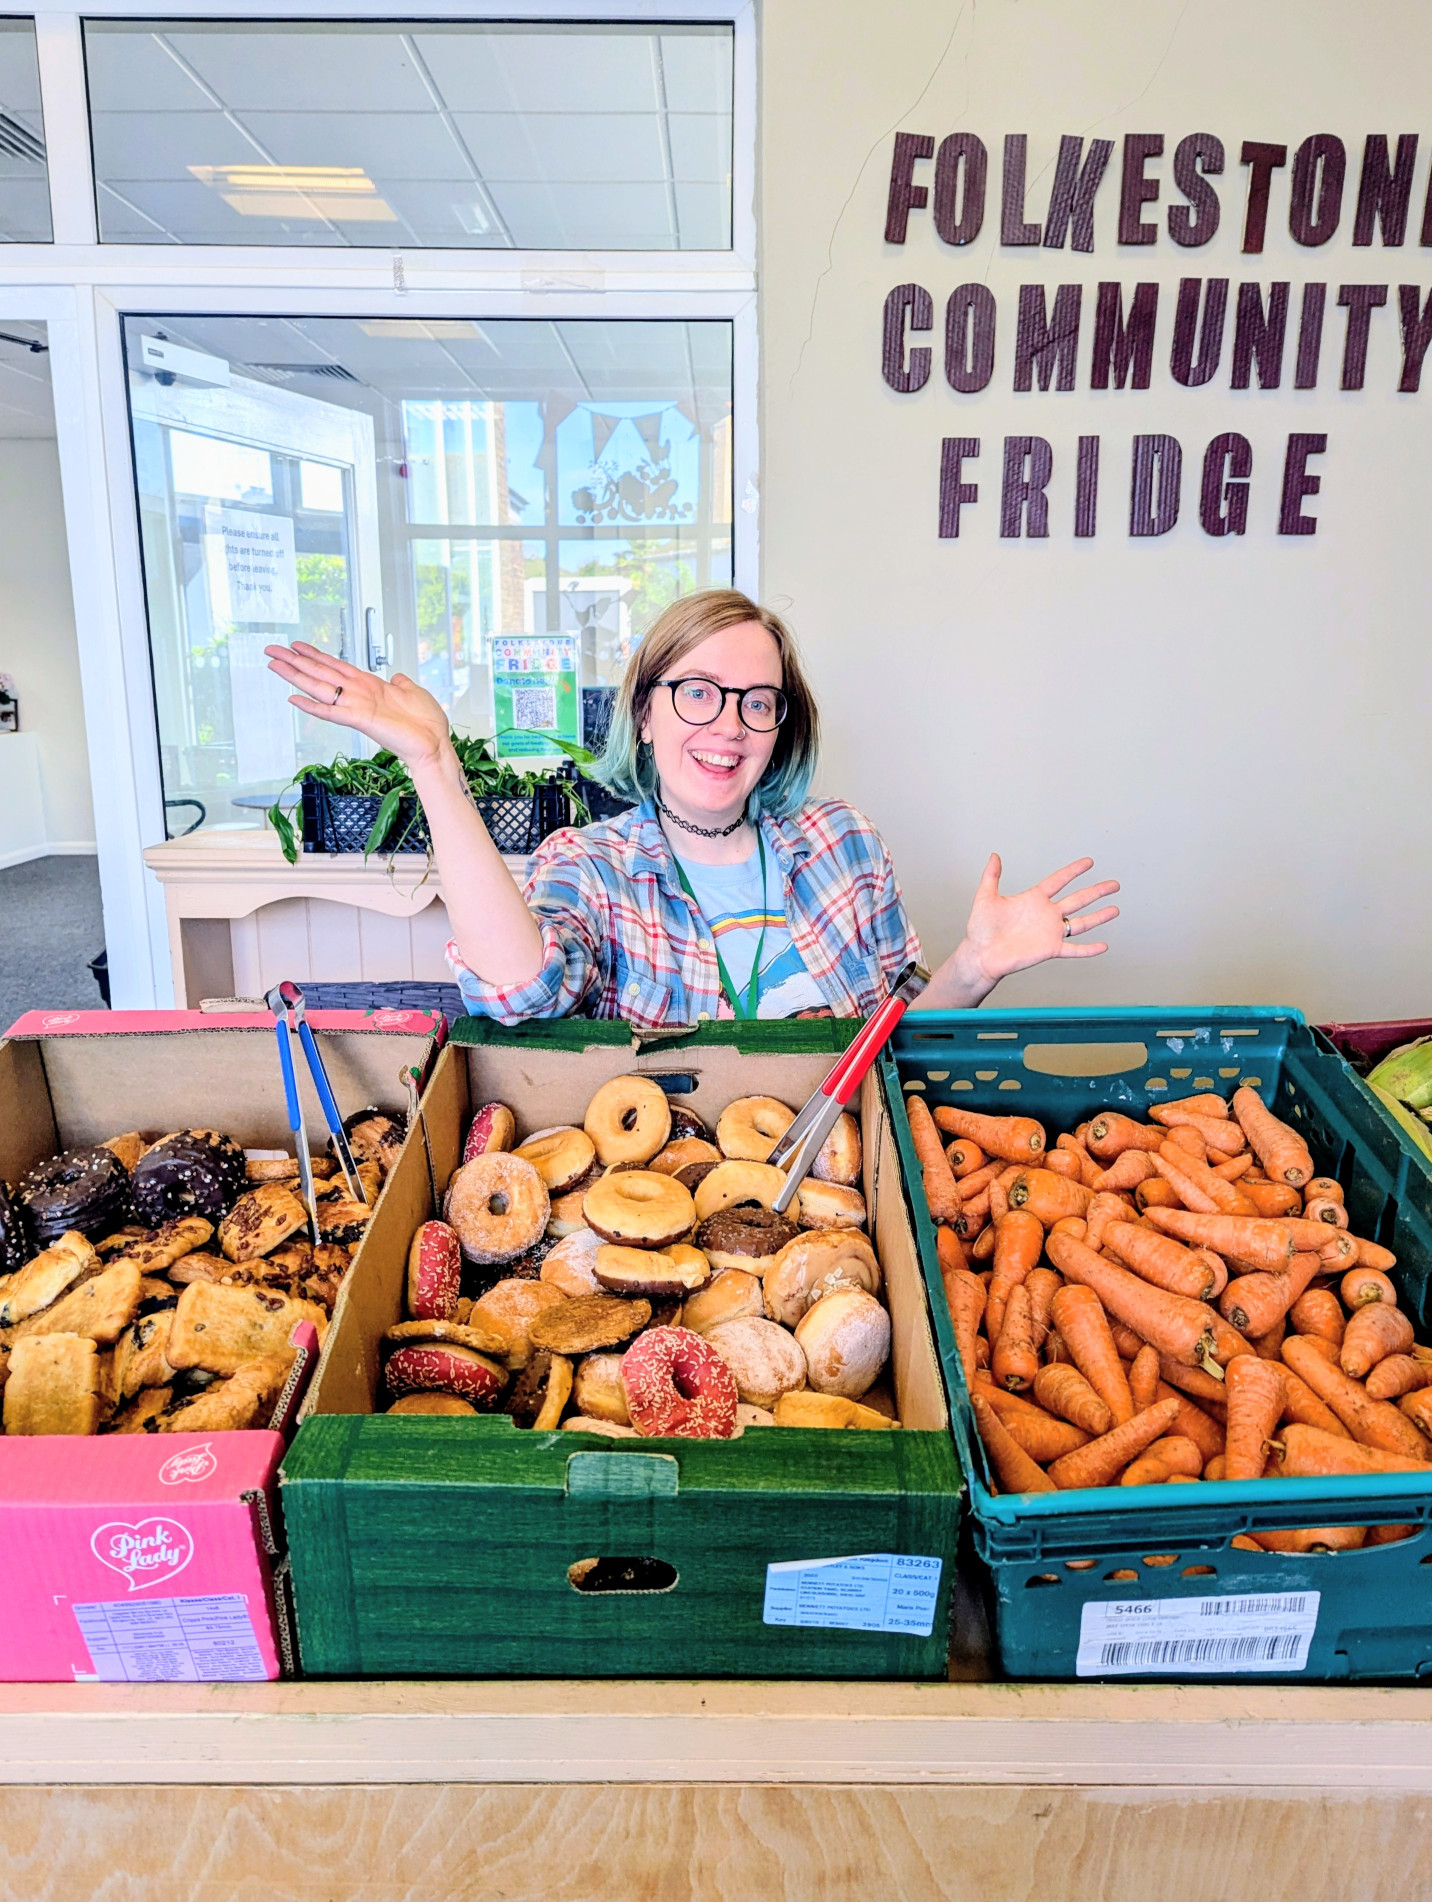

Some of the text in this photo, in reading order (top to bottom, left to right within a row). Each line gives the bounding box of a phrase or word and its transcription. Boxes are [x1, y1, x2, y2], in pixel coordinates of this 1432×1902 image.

[882, 278, 1432, 392] COMMUNITY
[939, 432, 1327, 537] FRIDGE
[222, 526, 280, 541] Please ensure all
[240, 547, 250, 555] are
[252, 547, 274, 557] turned
[275, 549, 284, 558] off
[228, 562, 251, 573] before
[237, 581, 256, 591] Thank
[496, 658, 571, 670] FRIDGE
[109, 1524, 173, 1558] Pink
[122, 1544, 180, 1572] Lady
[897, 1558, 940, 1569] 83263
[913, 1590, 936, 1598] 500g
[1115, 1605, 1152, 1614] 5466
